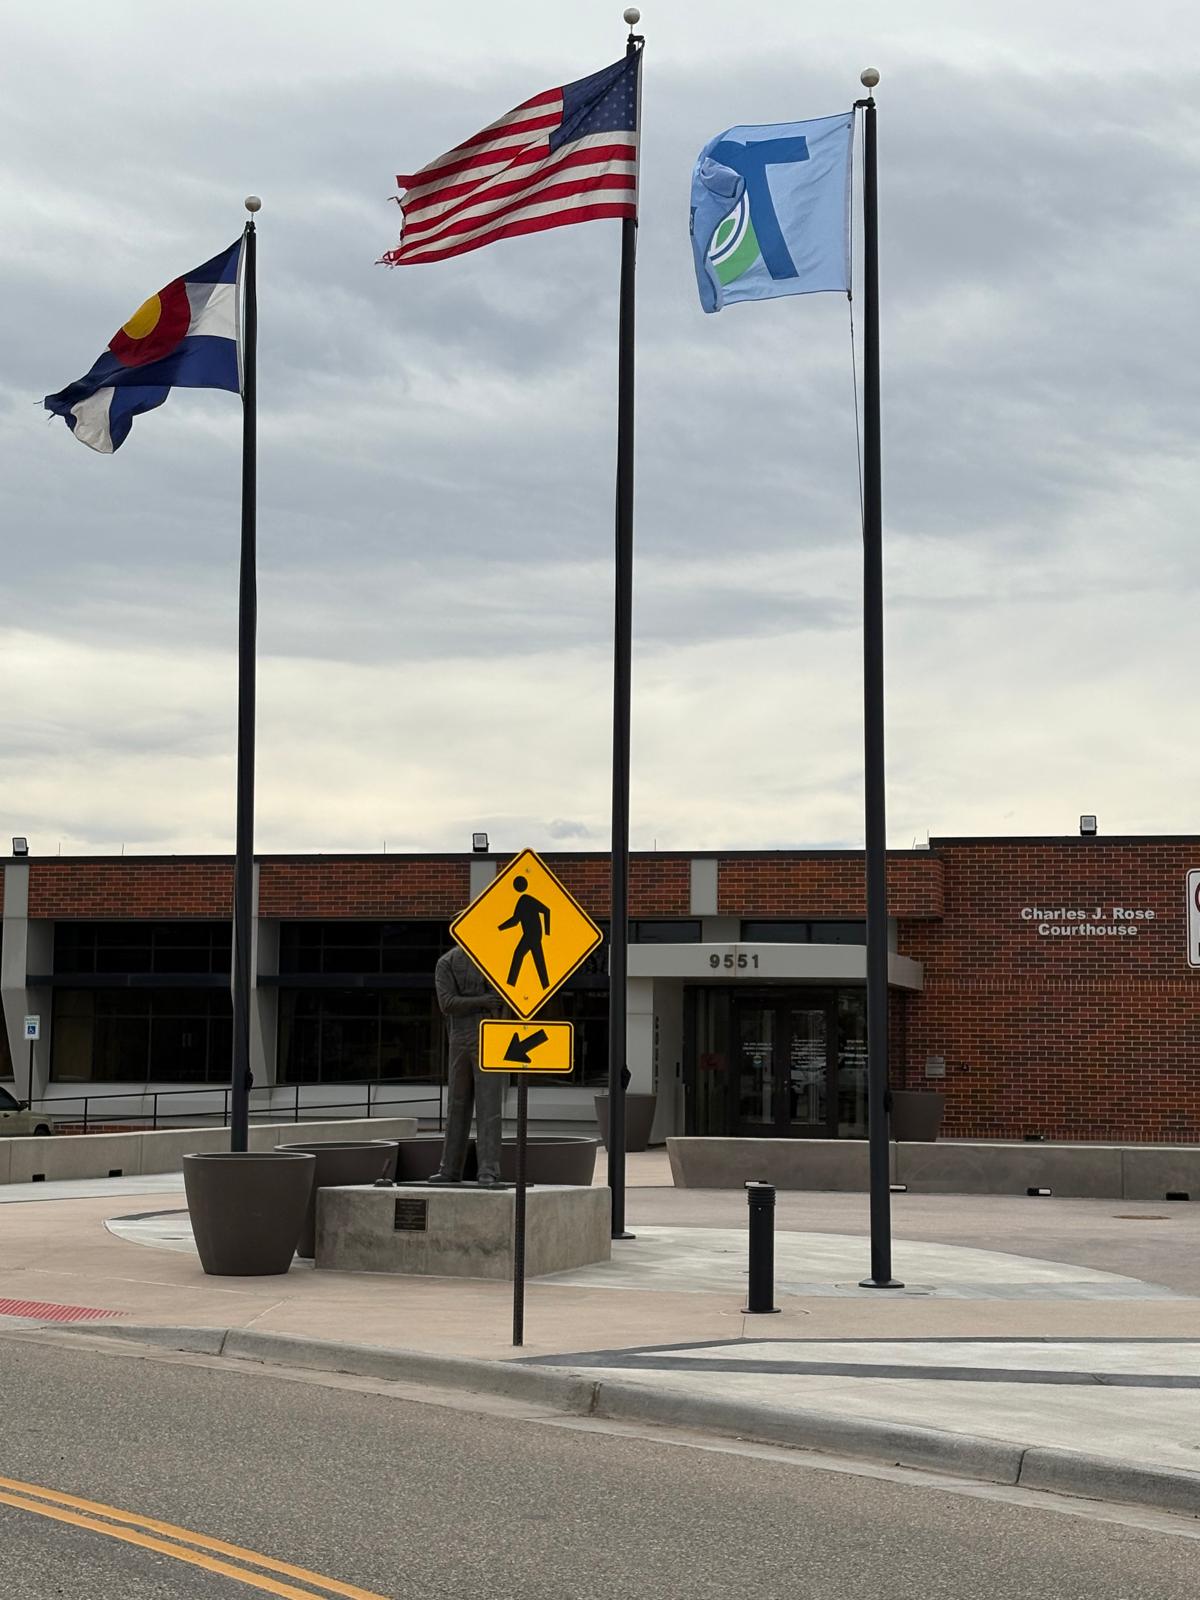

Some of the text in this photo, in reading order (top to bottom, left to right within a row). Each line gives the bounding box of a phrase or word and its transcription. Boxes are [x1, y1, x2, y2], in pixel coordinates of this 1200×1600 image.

[1021, 907, 1155, 920] Charles J. Rose
[1038, 923, 1138, 936] Courthouse
[709, 954, 759, 969] 9551
